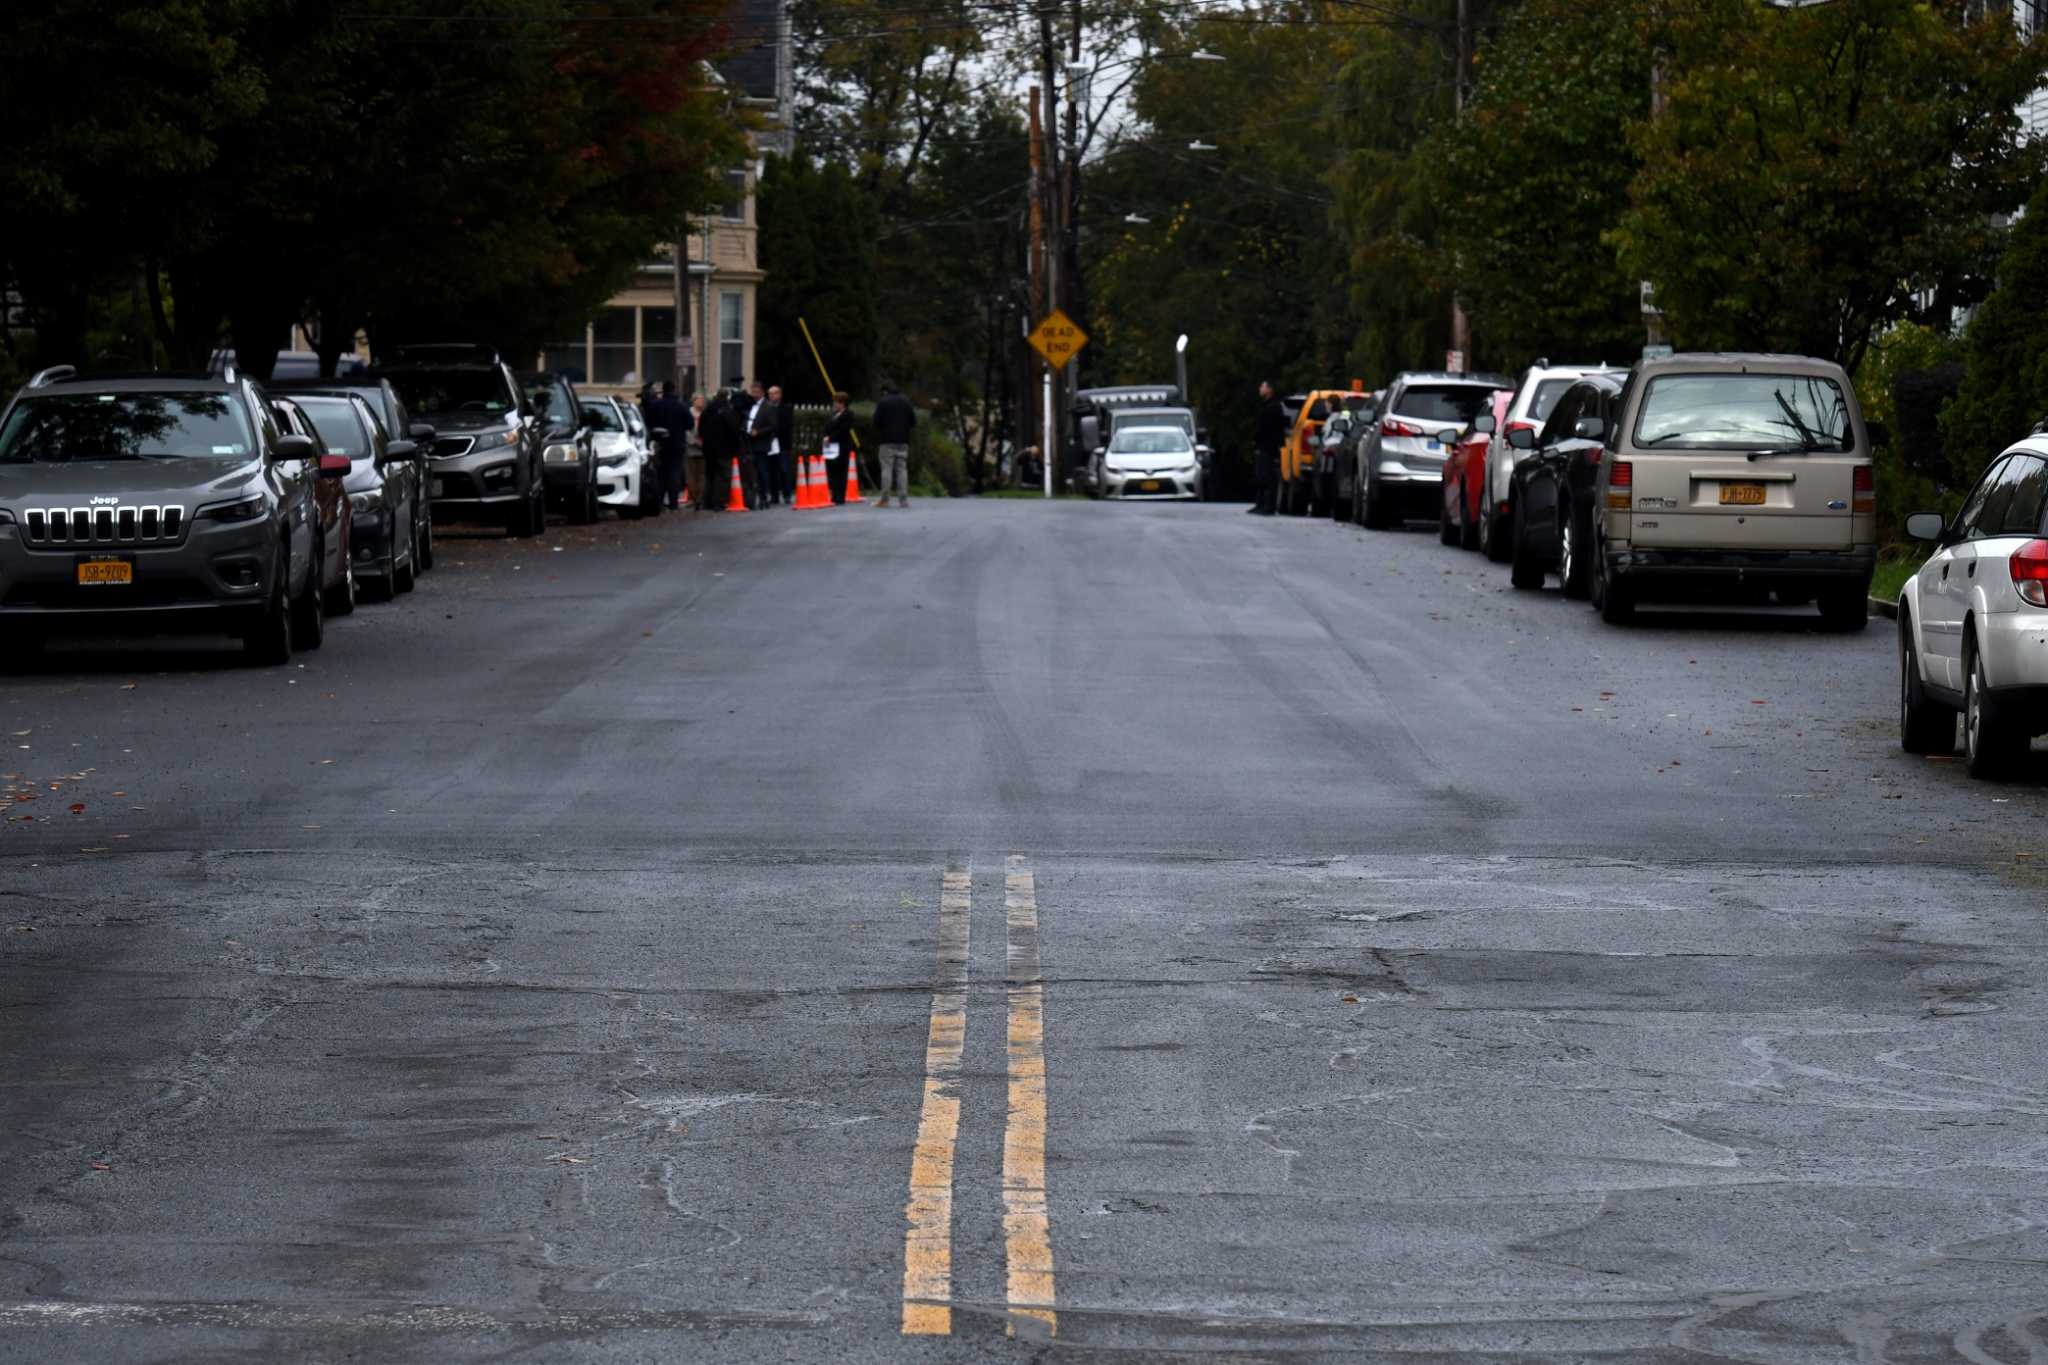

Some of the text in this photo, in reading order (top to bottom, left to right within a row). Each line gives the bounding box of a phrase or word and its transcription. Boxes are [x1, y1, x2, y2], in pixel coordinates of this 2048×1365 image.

[1042, 327, 1075, 337] DEAD
[1047, 342, 1070, 353] END
[89, 496, 120, 505] Jeep
